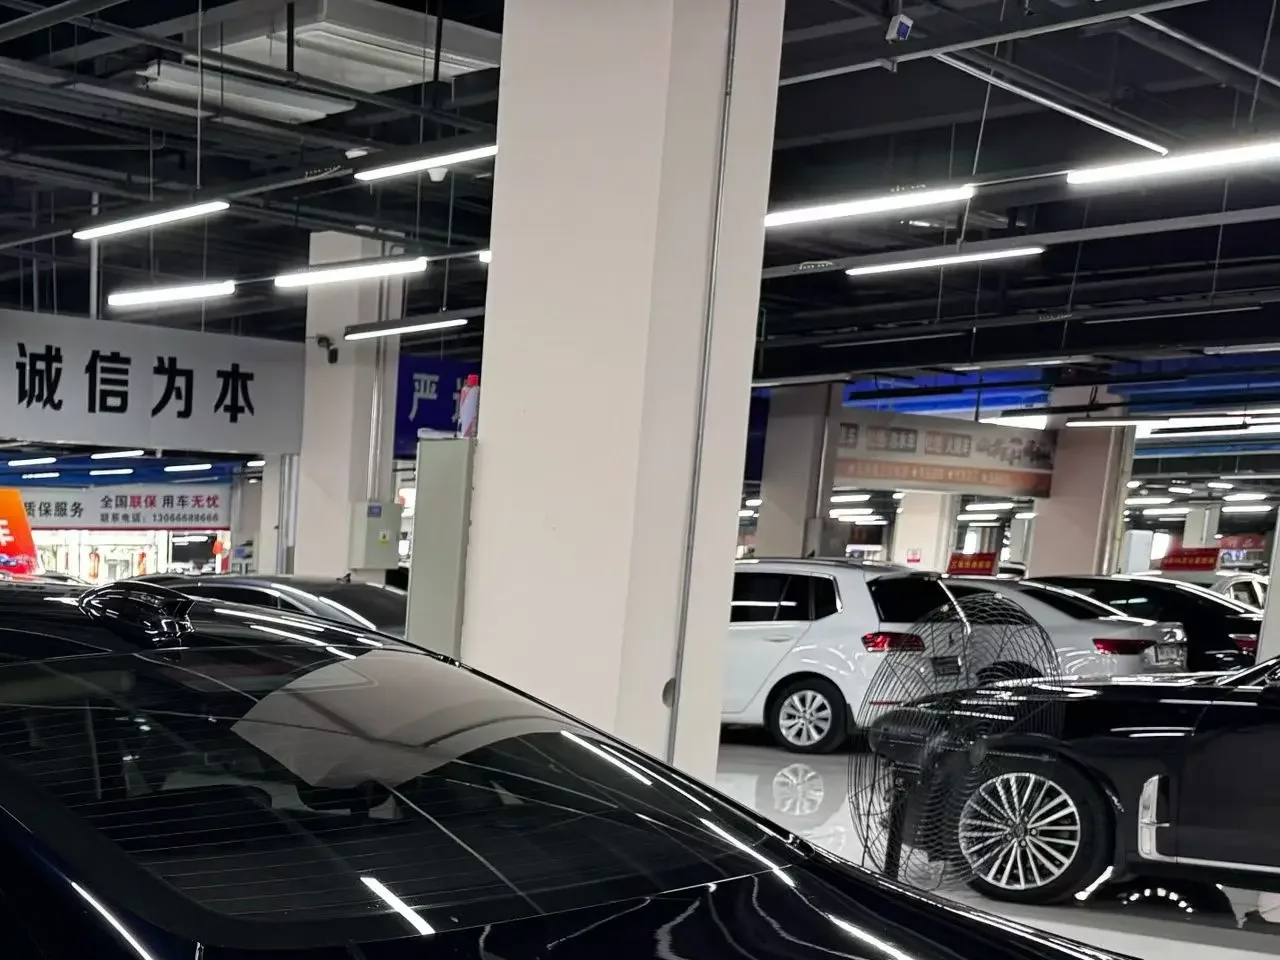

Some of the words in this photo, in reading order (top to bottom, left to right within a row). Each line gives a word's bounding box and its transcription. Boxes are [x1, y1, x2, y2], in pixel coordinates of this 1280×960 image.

[16, 342, 255, 424] 诚信为本
[100, 494, 157, 510] 全国联保
[161, 494, 220, 509] 用车无忧
